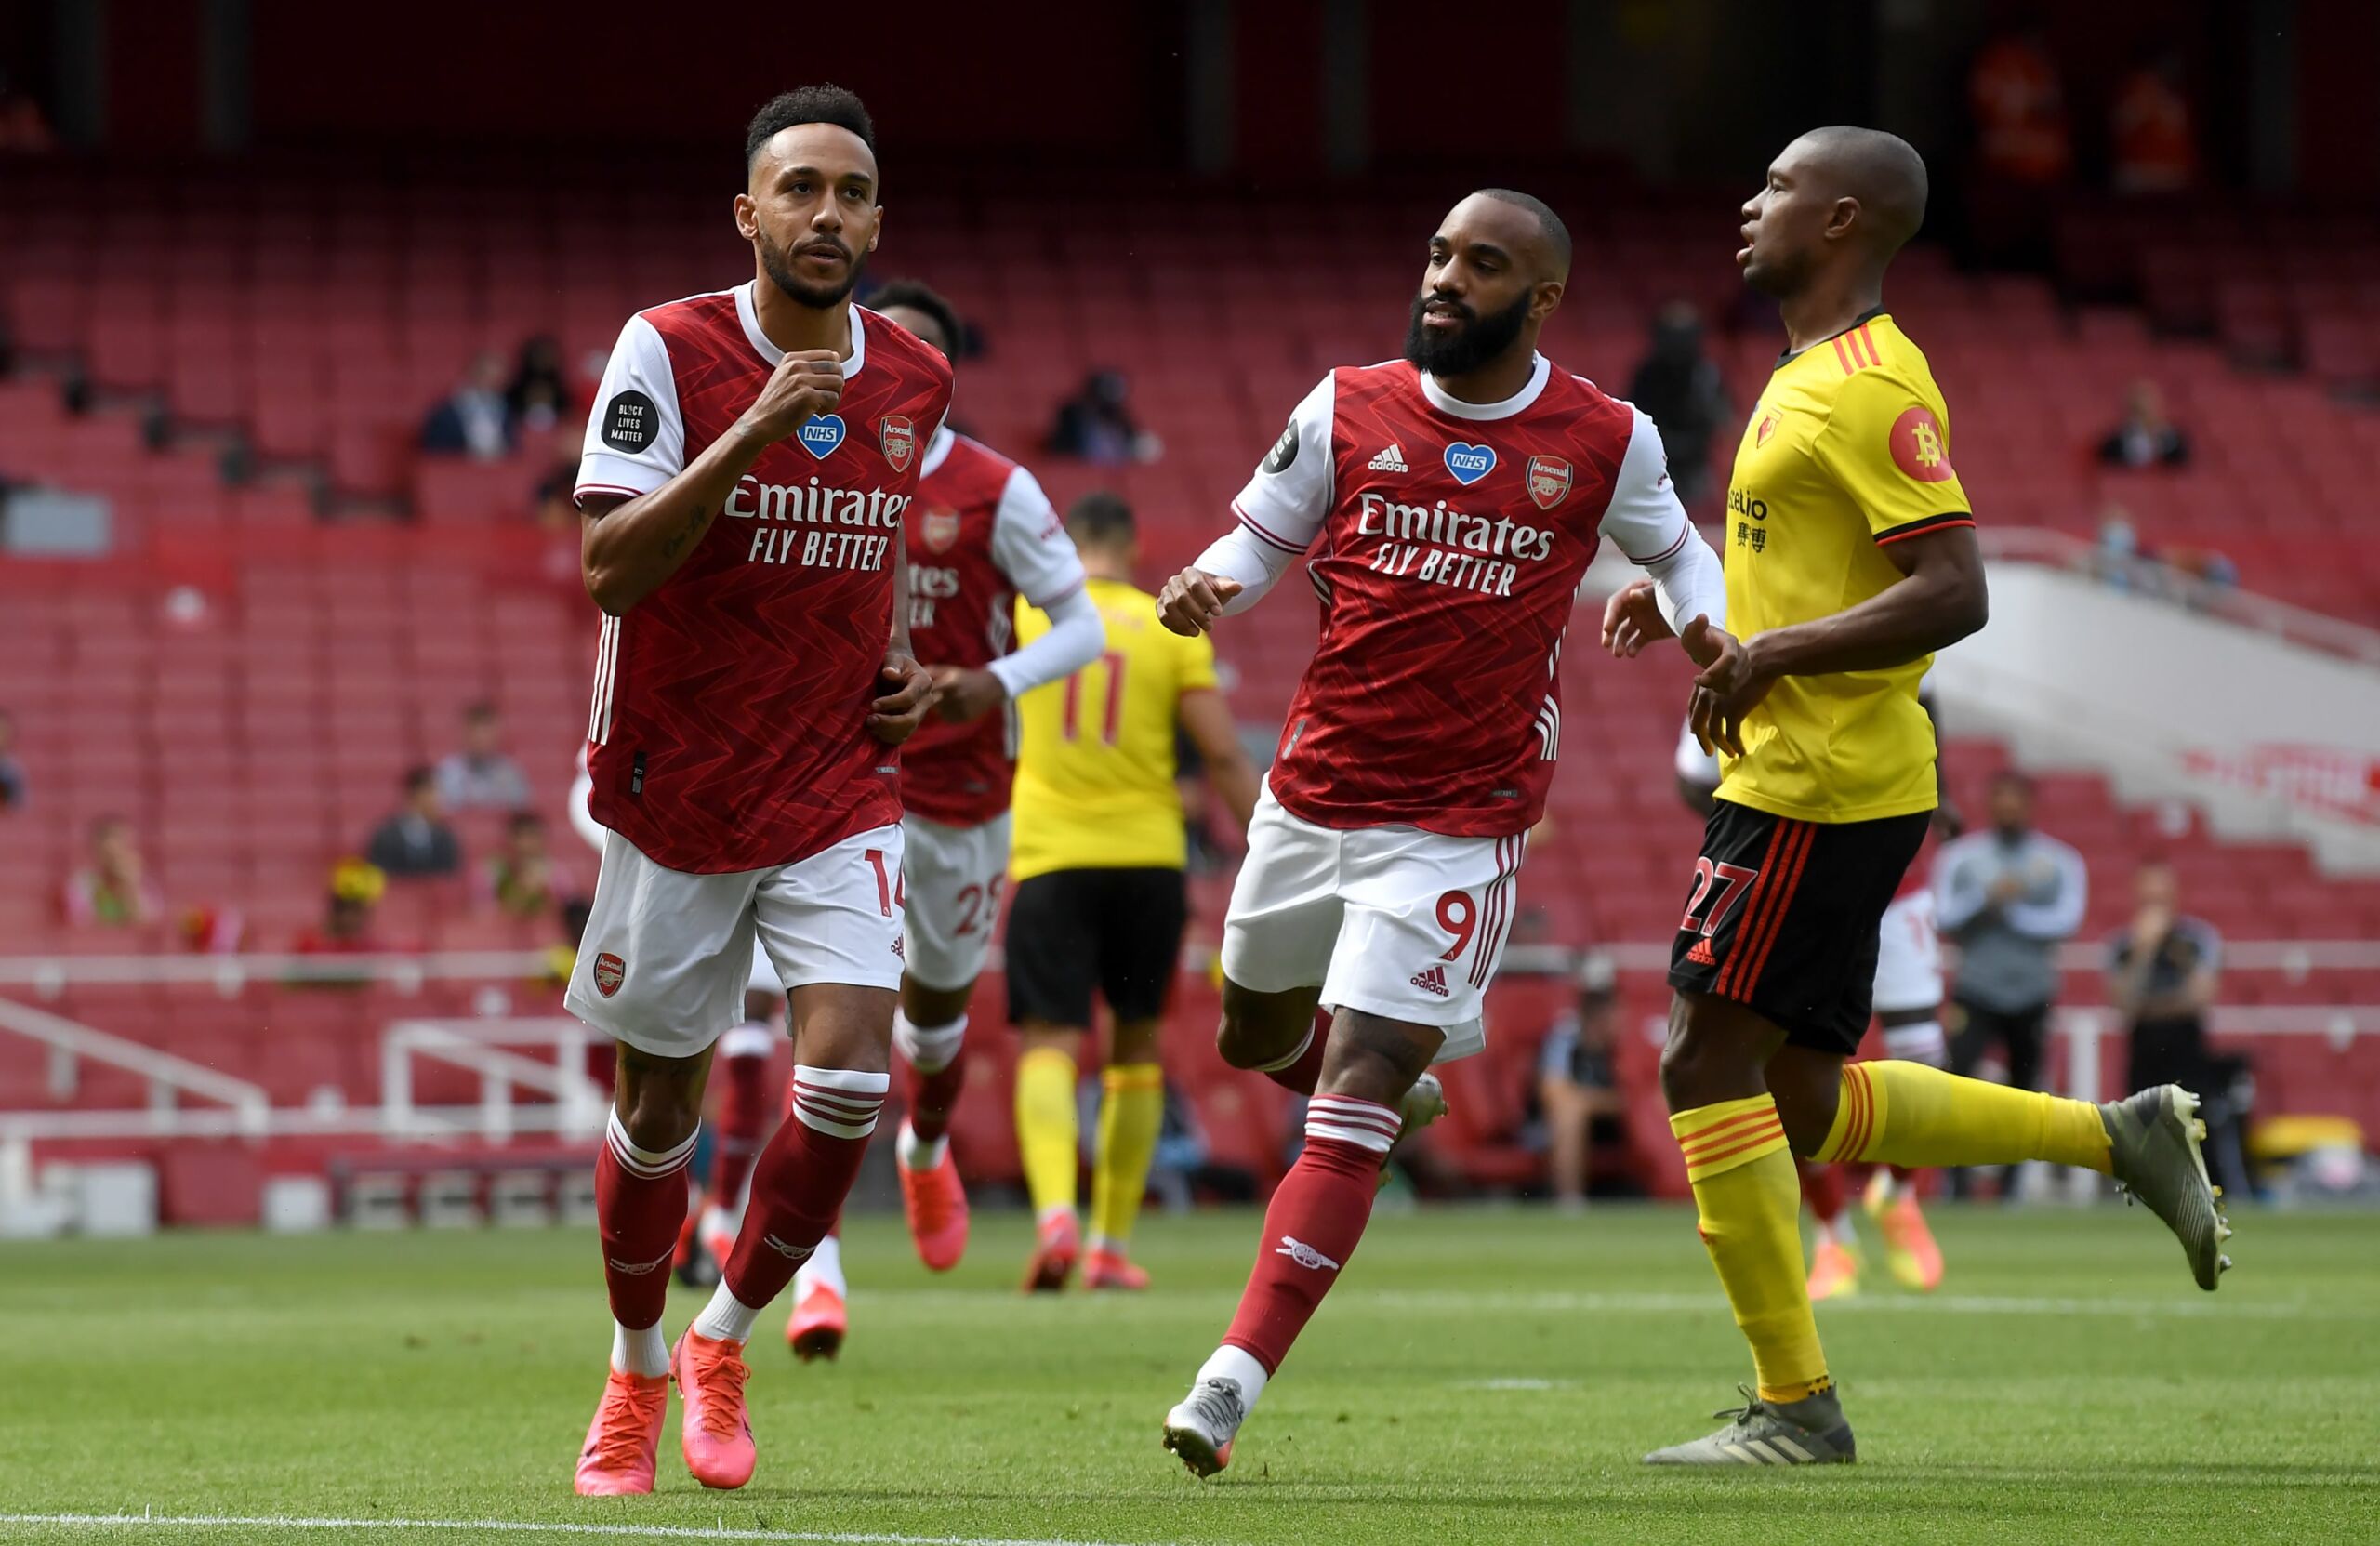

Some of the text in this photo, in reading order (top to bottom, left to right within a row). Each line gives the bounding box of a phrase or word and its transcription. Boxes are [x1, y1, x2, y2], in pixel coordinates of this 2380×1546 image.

[617, 417, 641, 429] LIVES
[611, 429, 643, 443] MATTER
[806, 428, 835, 440] NHS
[1368, 459, 1408, 472] adidas
[1453, 455, 1485, 469] NHS
[1534, 462, 1567, 477] Arsenal
[1357, 493, 1555, 562] Emirates
[748, 527, 797, 564] FLY
[801, 531, 888, 571] BETTER
[1369, 542, 1517, 597] FLY BETTER
[1680, 856, 1759, 937] 27
[1435, 890, 1477, 962] 9
[1410, 976, 1450, 998] adidas
